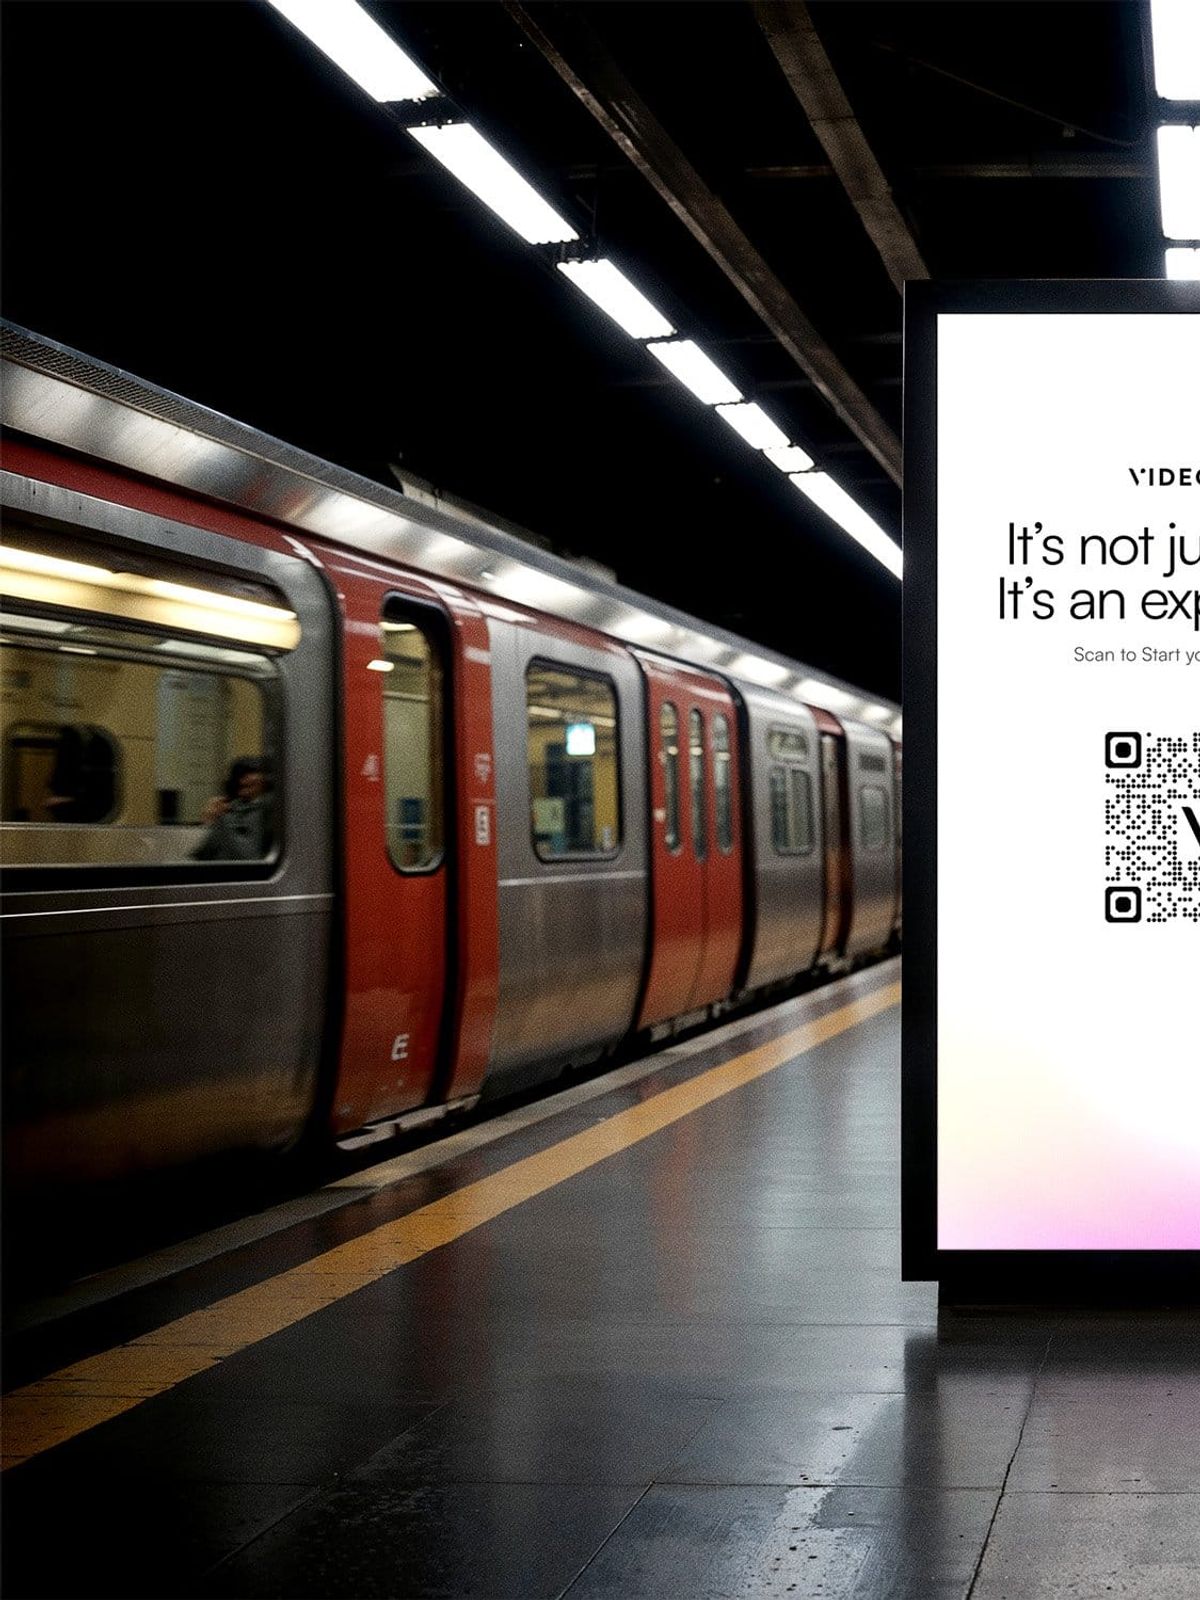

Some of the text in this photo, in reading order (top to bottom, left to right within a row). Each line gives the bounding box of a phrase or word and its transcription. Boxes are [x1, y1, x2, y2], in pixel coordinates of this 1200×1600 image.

[1008, 521, 1065, 566] It’s
[1080, 526, 1155, 566] not
[999, 576, 1055, 620] It’s
[1069, 589, 1126, 620] an
[1073, 646, 1115, 663] Scan
[1120, 648, 1137, 663] to
[1141, 646, 1181, 663] Start
[390, 1033, 410, 1062] E
